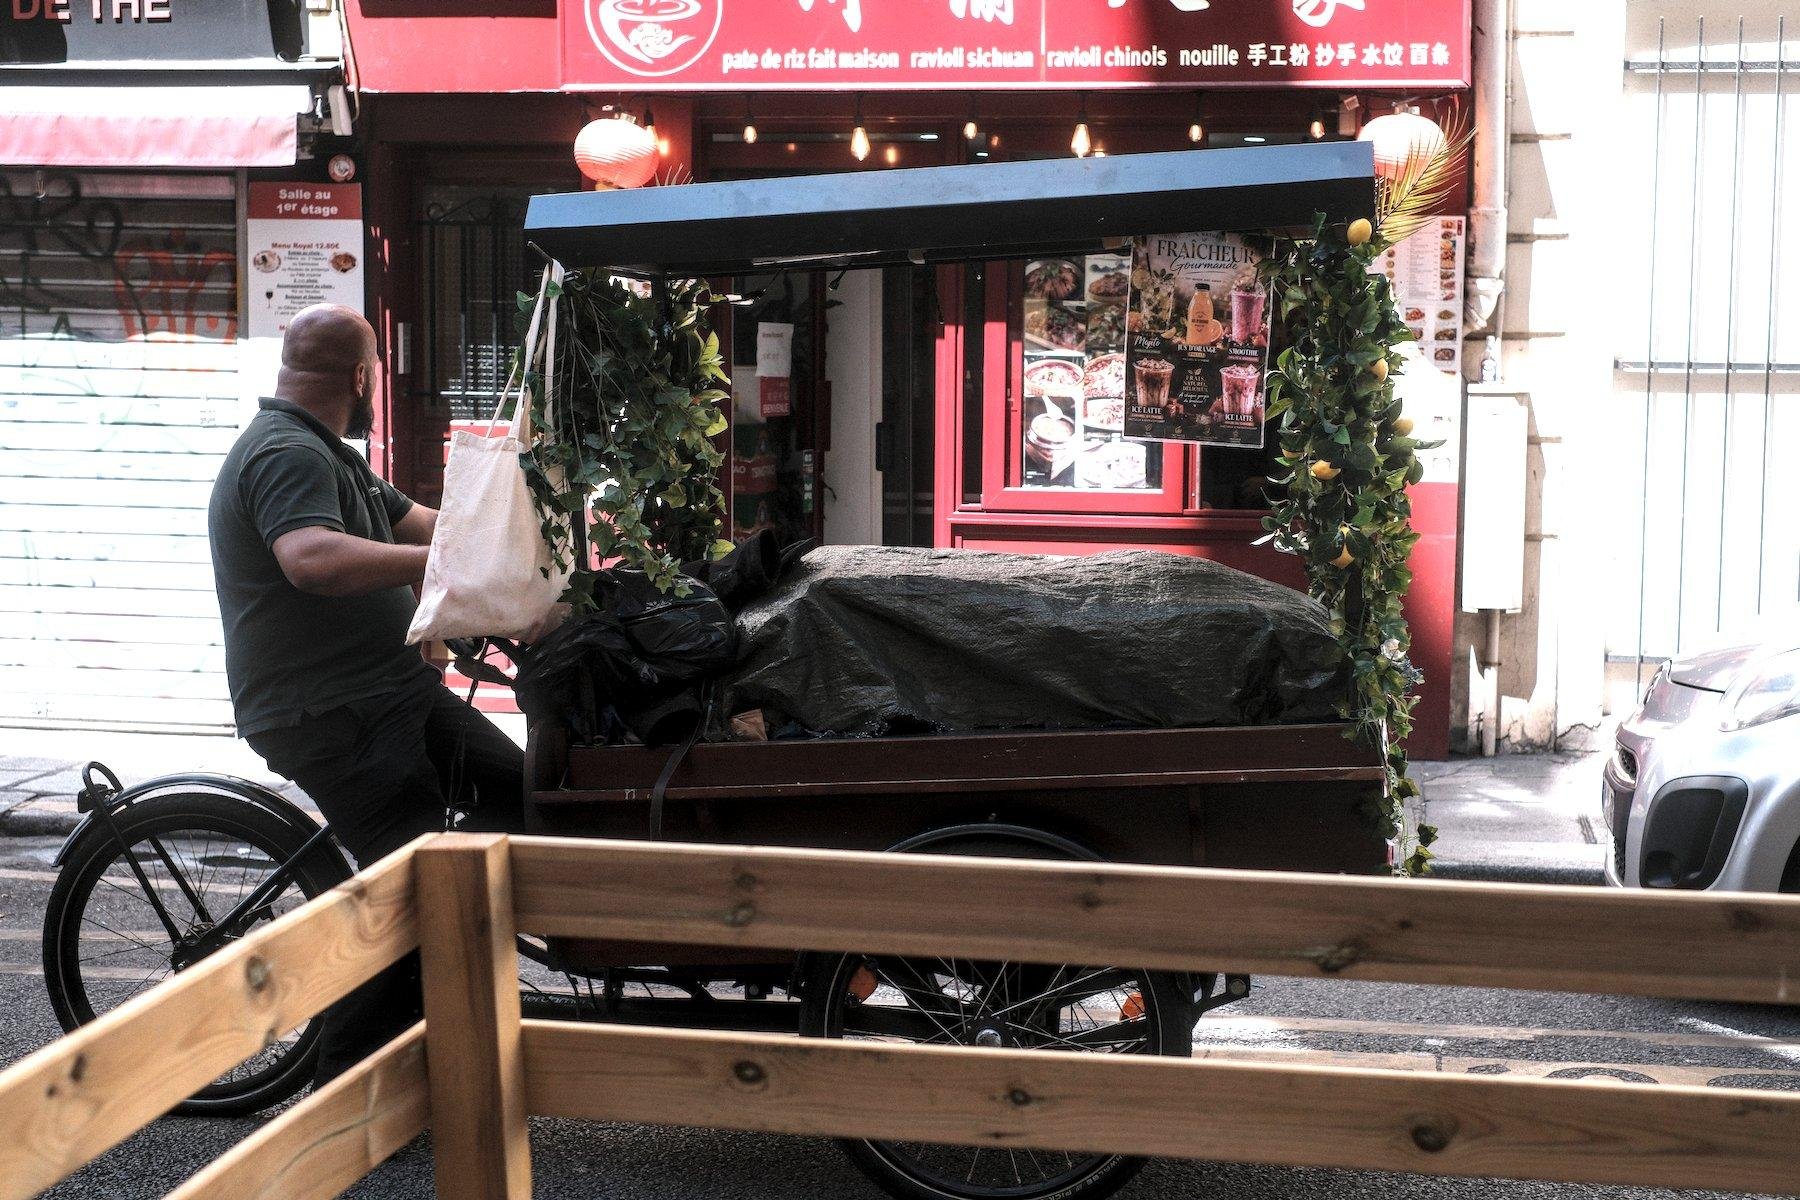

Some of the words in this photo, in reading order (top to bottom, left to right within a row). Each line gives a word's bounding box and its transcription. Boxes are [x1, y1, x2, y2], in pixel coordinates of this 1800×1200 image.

[721, 48, 759, 74] pate
[761, 48, 782, 69] de
[784, 48, 806, 69] riz
[808, 47, 837, 69] fait
[838, 47, 900, 69] maison
[910, 46, 964, 69] ravioli
[966, 46, 1034, 68] sichuan
[1046, 45, 1101, 67] ravioli
[1104, 45, 1168, 67] chinois
[1179, 44, 1240, 66] nouille
[1247, 42, 1311, 67] 手工粉
[1314, 42, 1357, 67] 抄手
[279, 188, 312, 200] Salle
[315, 190, 331, 200] au
[276, 202, 298, 215] 1er
[300, 203, 339, 218] étage
[1157, 239, 1255, 265] FRAÎCHEUR
[1170, 255, 1238, 275] Gourmande
[1134, 335, 1161, 349] Mojito
[1229, 348, 1259, 356] SMOOTHIE
[1131, 405, 1142, 413] ICE
[1143, 406, 1162, 415] LATTE
[1225, 413, 1235, 421] ICE
[1235, 414, 1254, 422] LATTE
